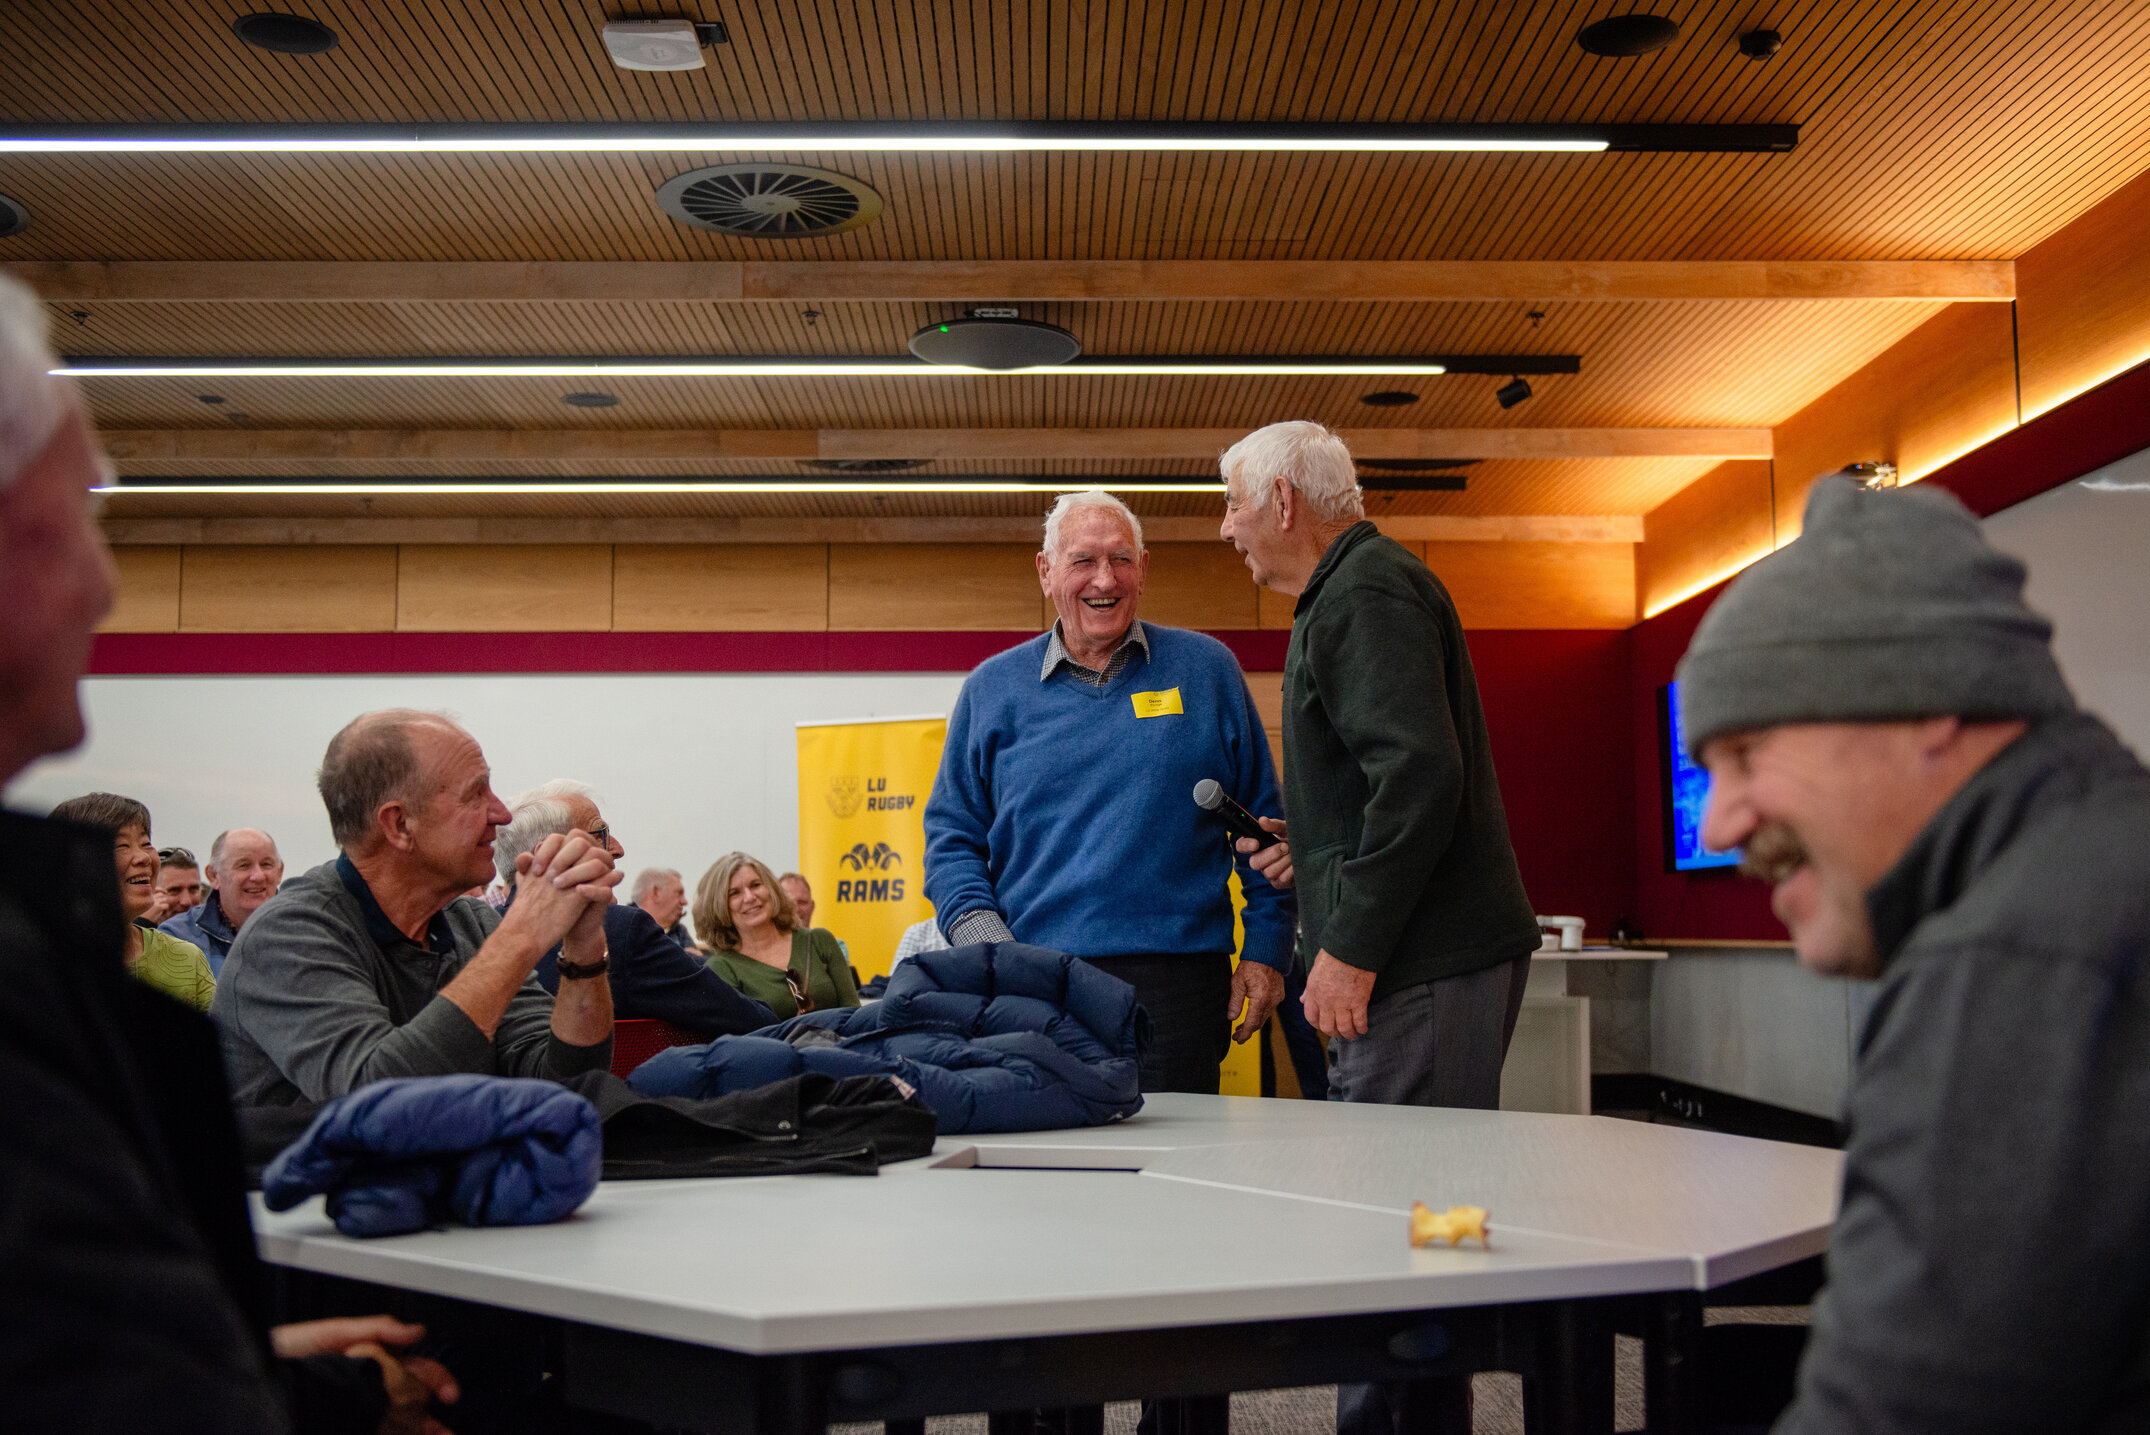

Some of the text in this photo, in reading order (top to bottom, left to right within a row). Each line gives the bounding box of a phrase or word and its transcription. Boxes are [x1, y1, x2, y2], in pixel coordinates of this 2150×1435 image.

[867, 778, 886, 792] LU
[867, 795, 915, 811] RUGBY
[837, 878, 904, 902] RAMS
